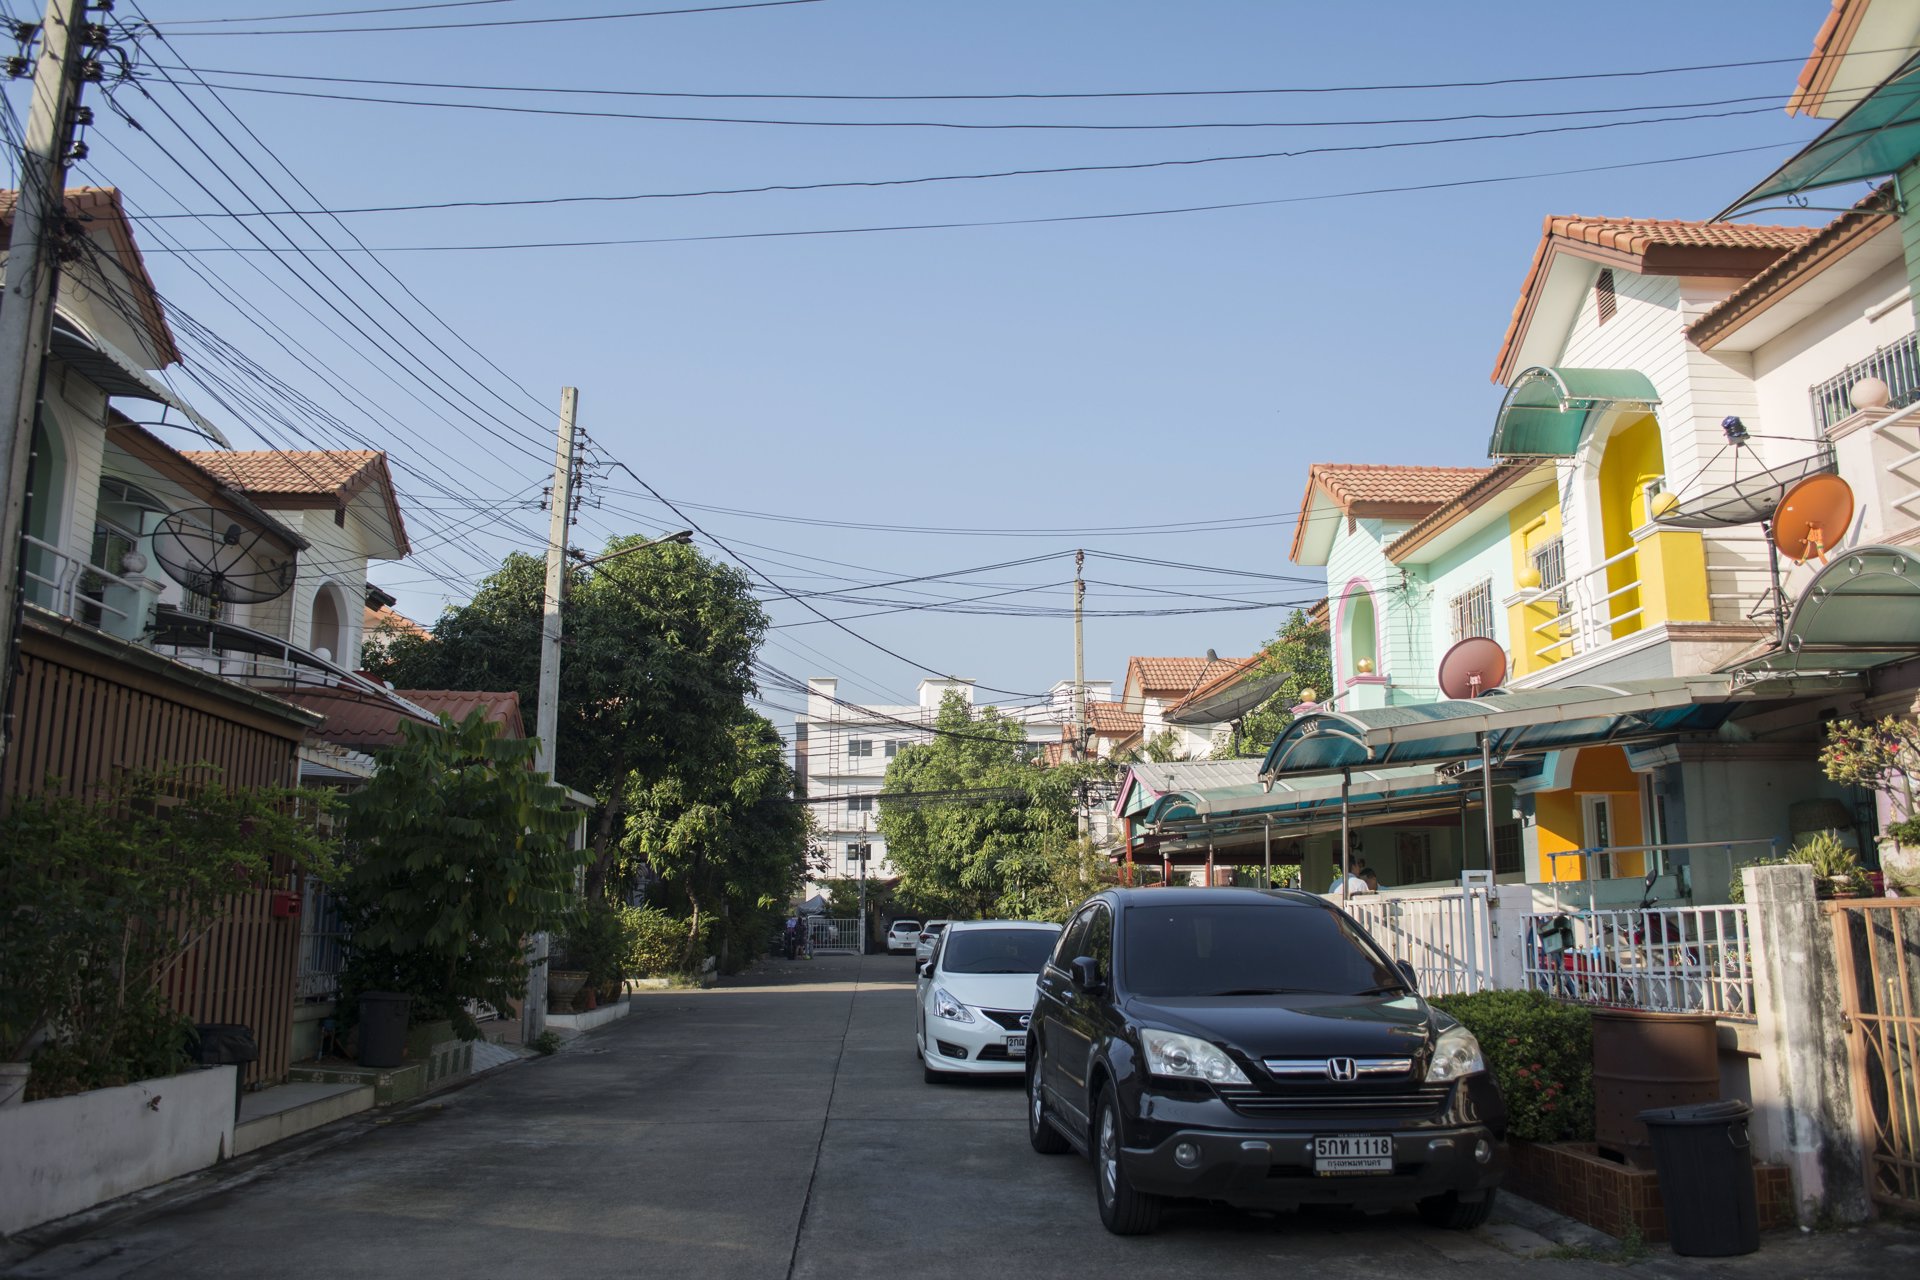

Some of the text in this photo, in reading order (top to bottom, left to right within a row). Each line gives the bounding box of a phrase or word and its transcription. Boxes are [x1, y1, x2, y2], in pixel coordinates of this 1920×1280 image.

[1318, 1139, 1389, 1155] 5กท 1118
[1327, 1159, 1382, 1169] กรุงเทพมหานคร
